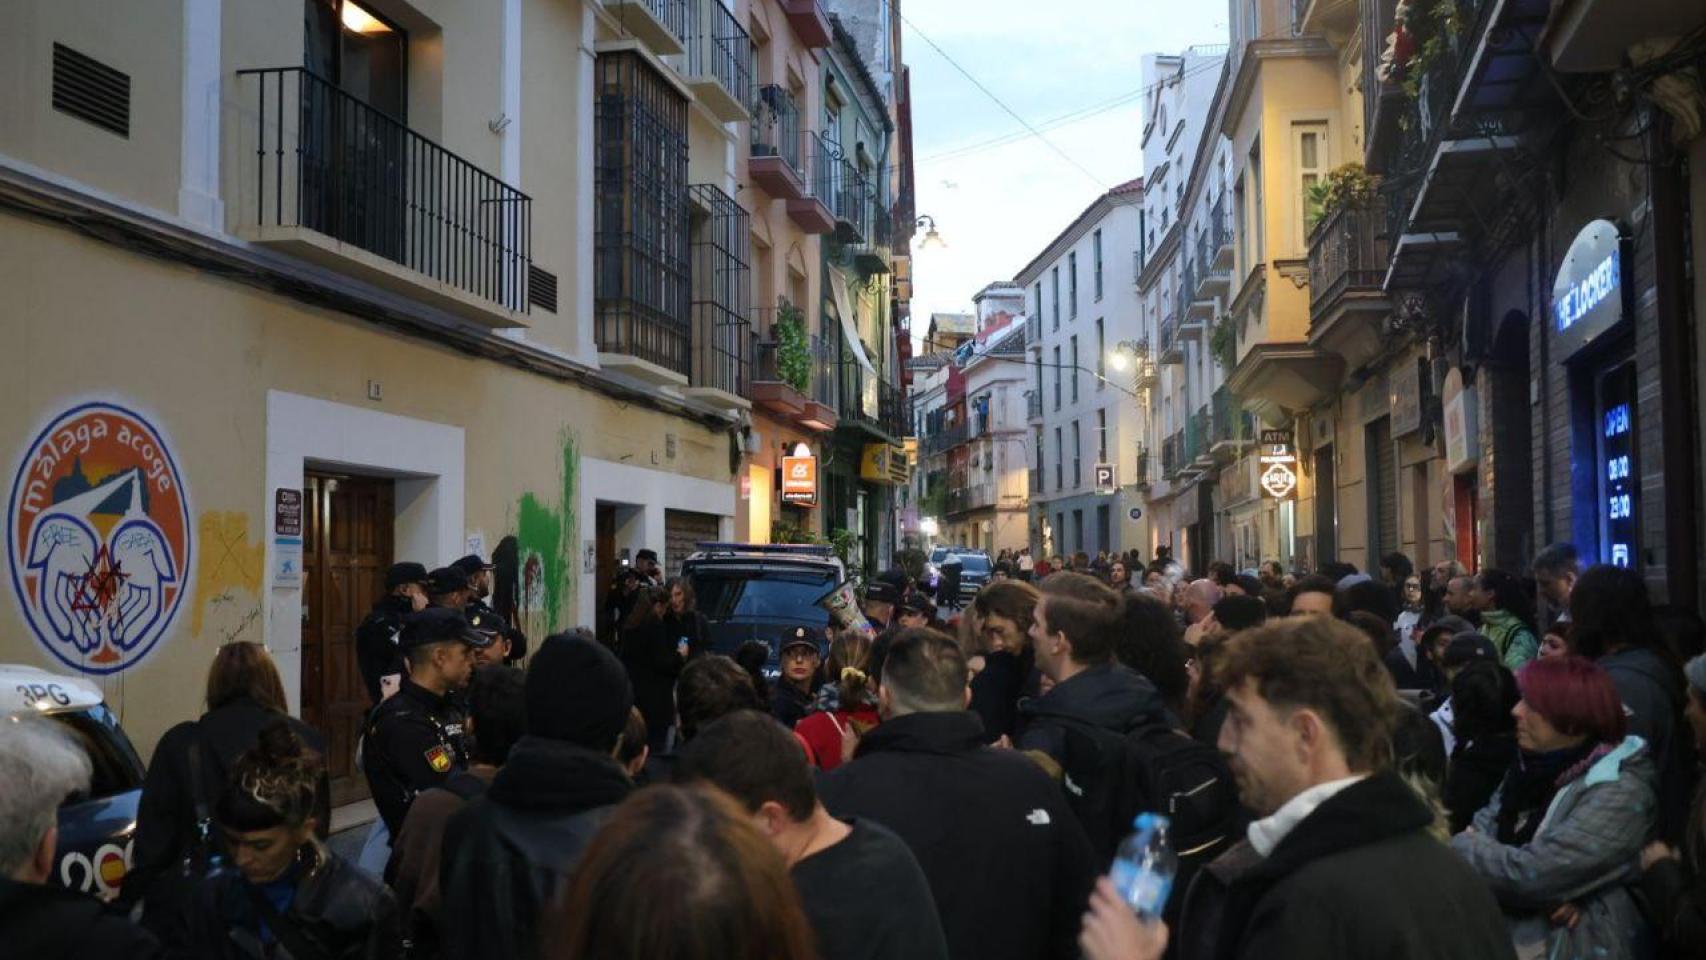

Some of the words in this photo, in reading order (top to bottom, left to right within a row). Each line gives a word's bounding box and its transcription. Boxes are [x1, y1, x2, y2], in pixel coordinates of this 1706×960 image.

[1605, 403, 1630, 438] OPEN
[1264, 431, 1290, 442] ATM
[117, 425, 170, 493] acoge
[1099, 470, 1110, 485] P
[16, 683, 70, 707] 3PG
